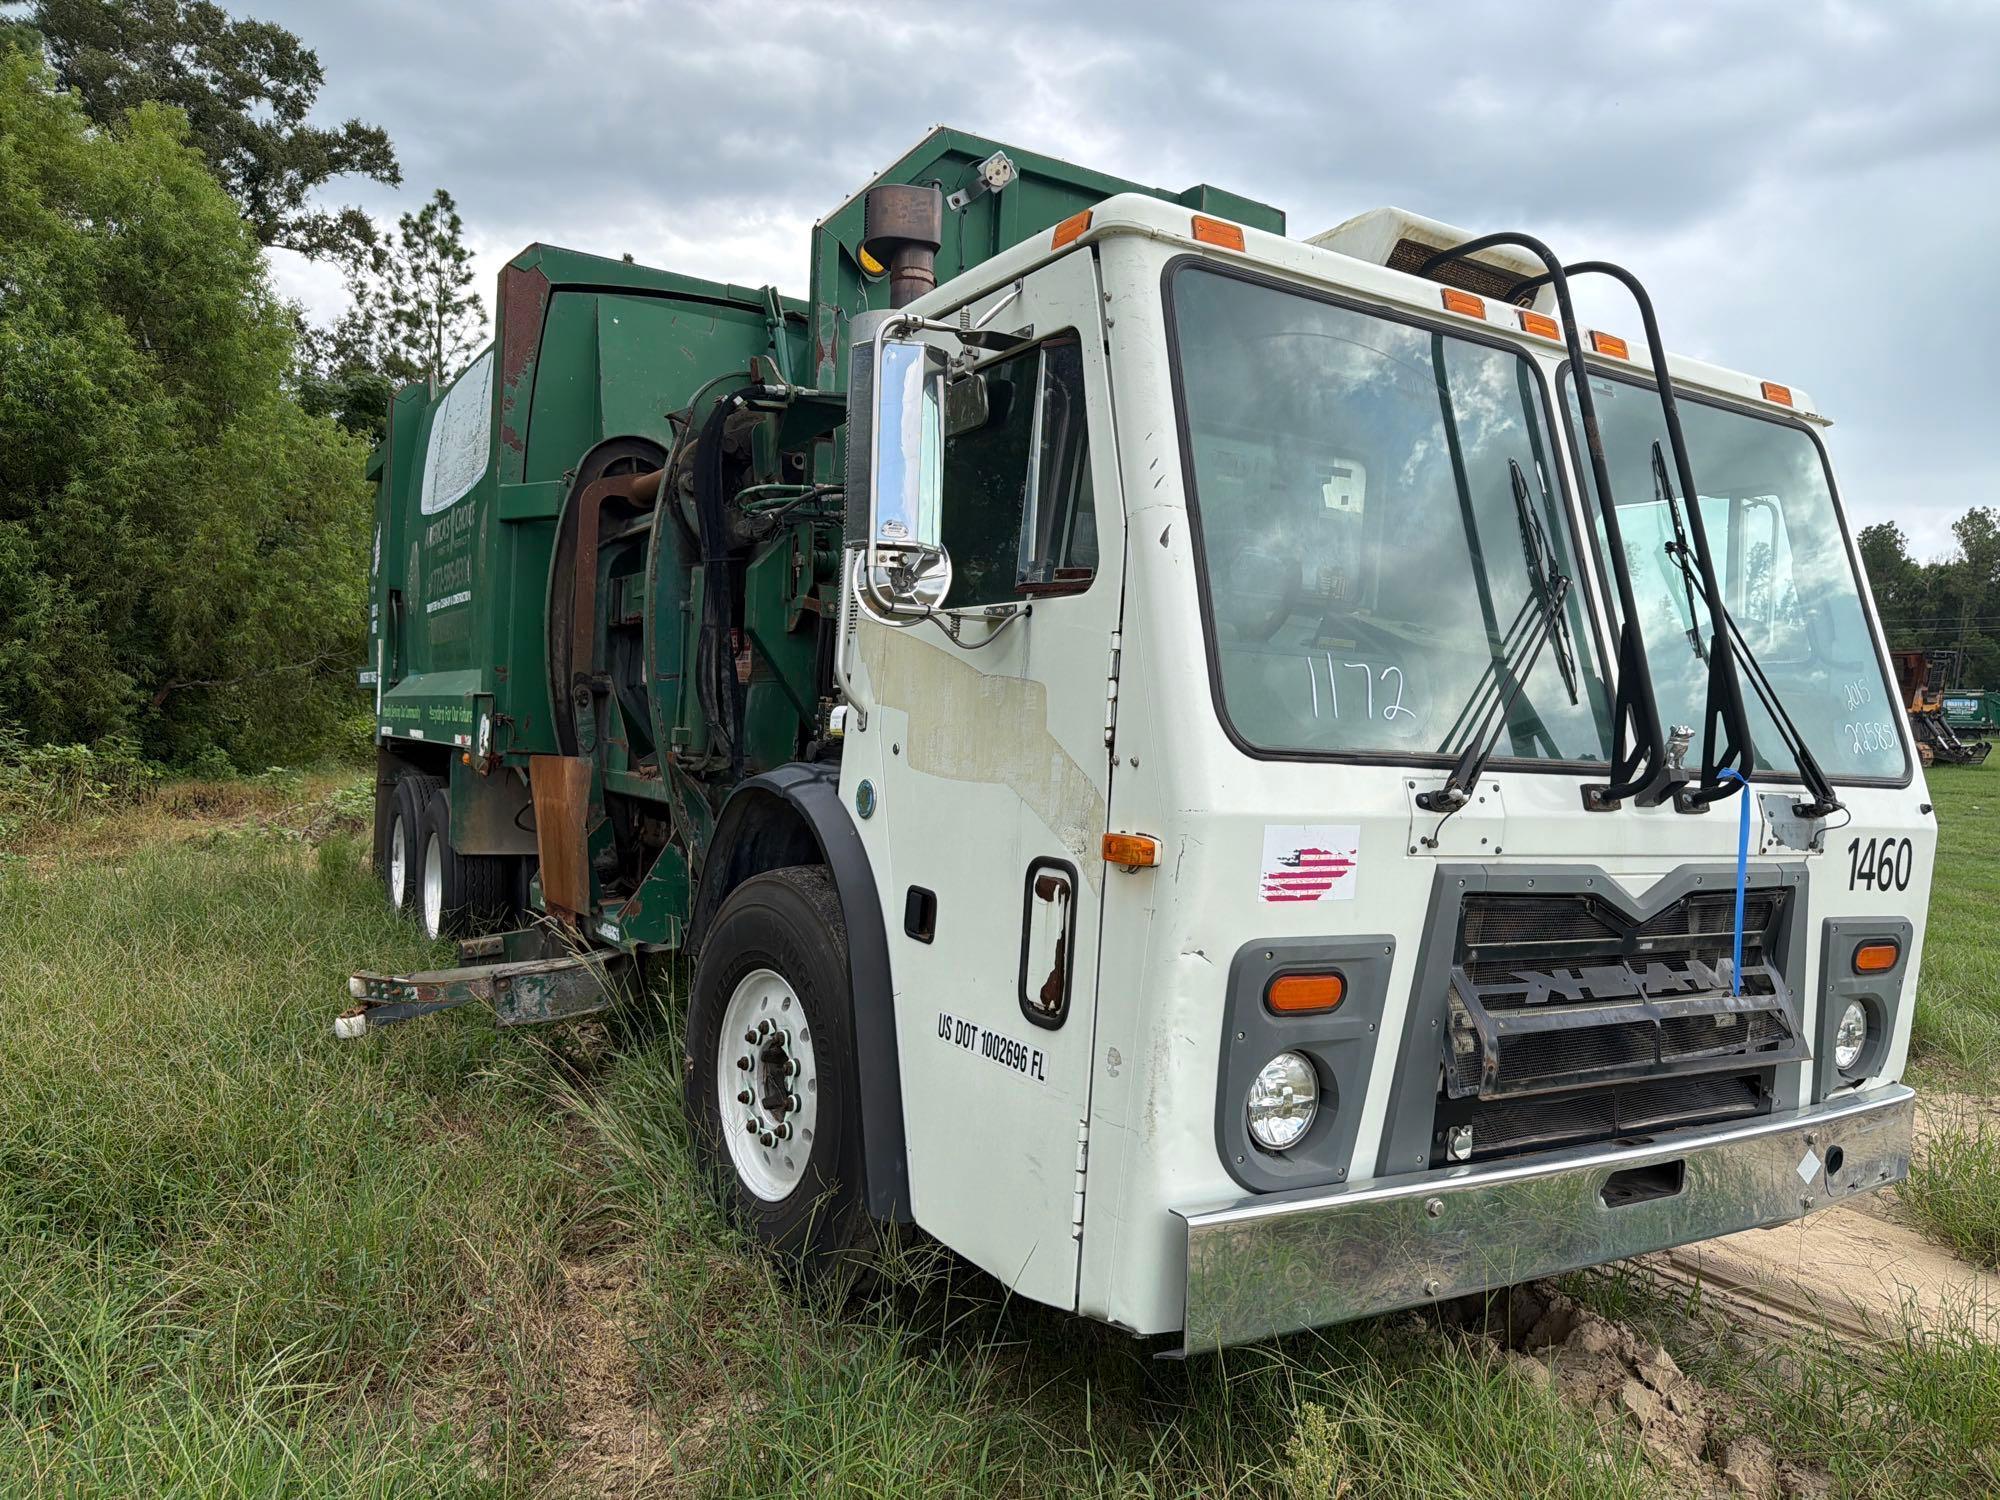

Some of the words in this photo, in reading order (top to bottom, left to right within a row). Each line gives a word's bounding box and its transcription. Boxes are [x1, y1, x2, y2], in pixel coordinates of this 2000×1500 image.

[1306, 651, 1417, 720] 1172
[1845, 722, 1898, 755] 225851
[1848, 837, 1912, 892] 1460
[938, 1012, 952, 1041] US
[955, 1019, 978, 1051] DOT
[981, 1030, 1028, 1073] 1002696
[1031, 1050, 1045, 1081] FL
